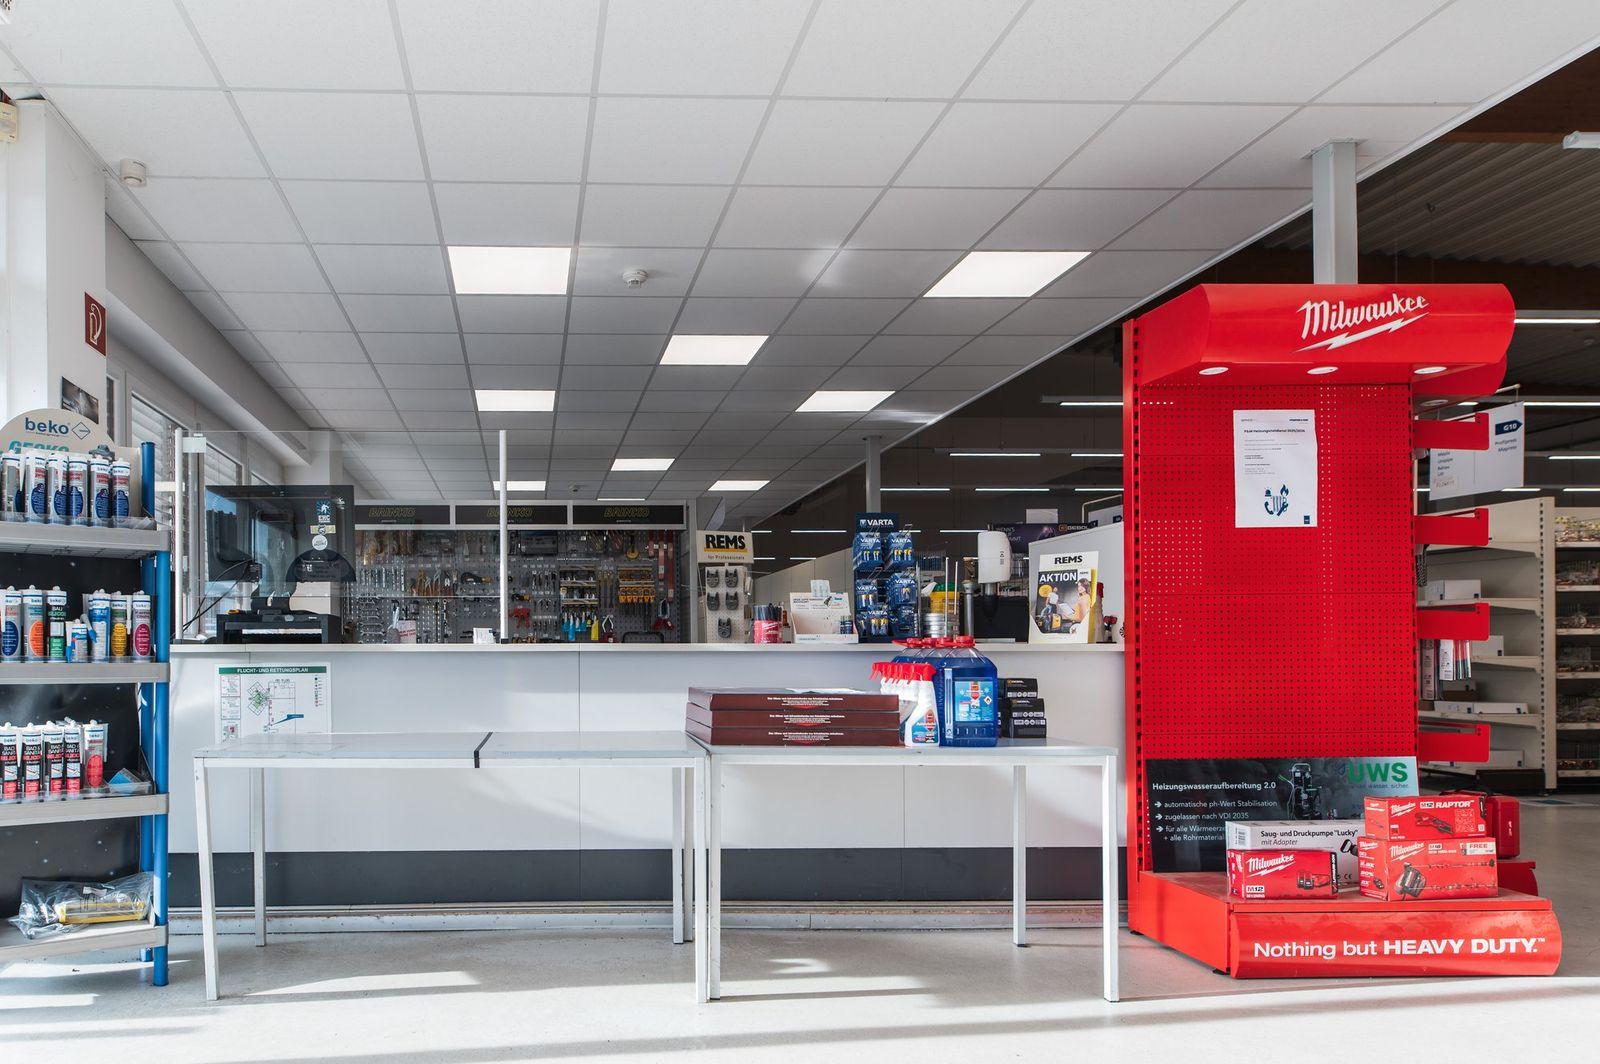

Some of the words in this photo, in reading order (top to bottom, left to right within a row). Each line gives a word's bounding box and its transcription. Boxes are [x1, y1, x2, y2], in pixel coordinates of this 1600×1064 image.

[1297, 293, 1430, 339] Milwaukee
[25, 417, 69, 434] beko
[1503, 423, 1517, 431] G10
[705, 534, 746, 550] REMS
[1054, 556, 1082, 564] REMS
[1039, 572, 1077, 583] AKTION
[1348, 762, 1408, 783] UWS
[1152, 782, 1262, 792] Heizungswasseraufbereitung
[1260, 830, 1278, 838] Saug-
[1293, 830, 1333, 838] Druckpumpe
[1261, 838, 1272, 846] mit
[1273, 838, 1298, 847] Adapter
[1246, 854, 1296, 872] Milwaukee
[1254, 942, 1336, 959] Nothing
[1343, 940, 1377, 957] but
[1383, 939, 1465, 955] HEAVY
